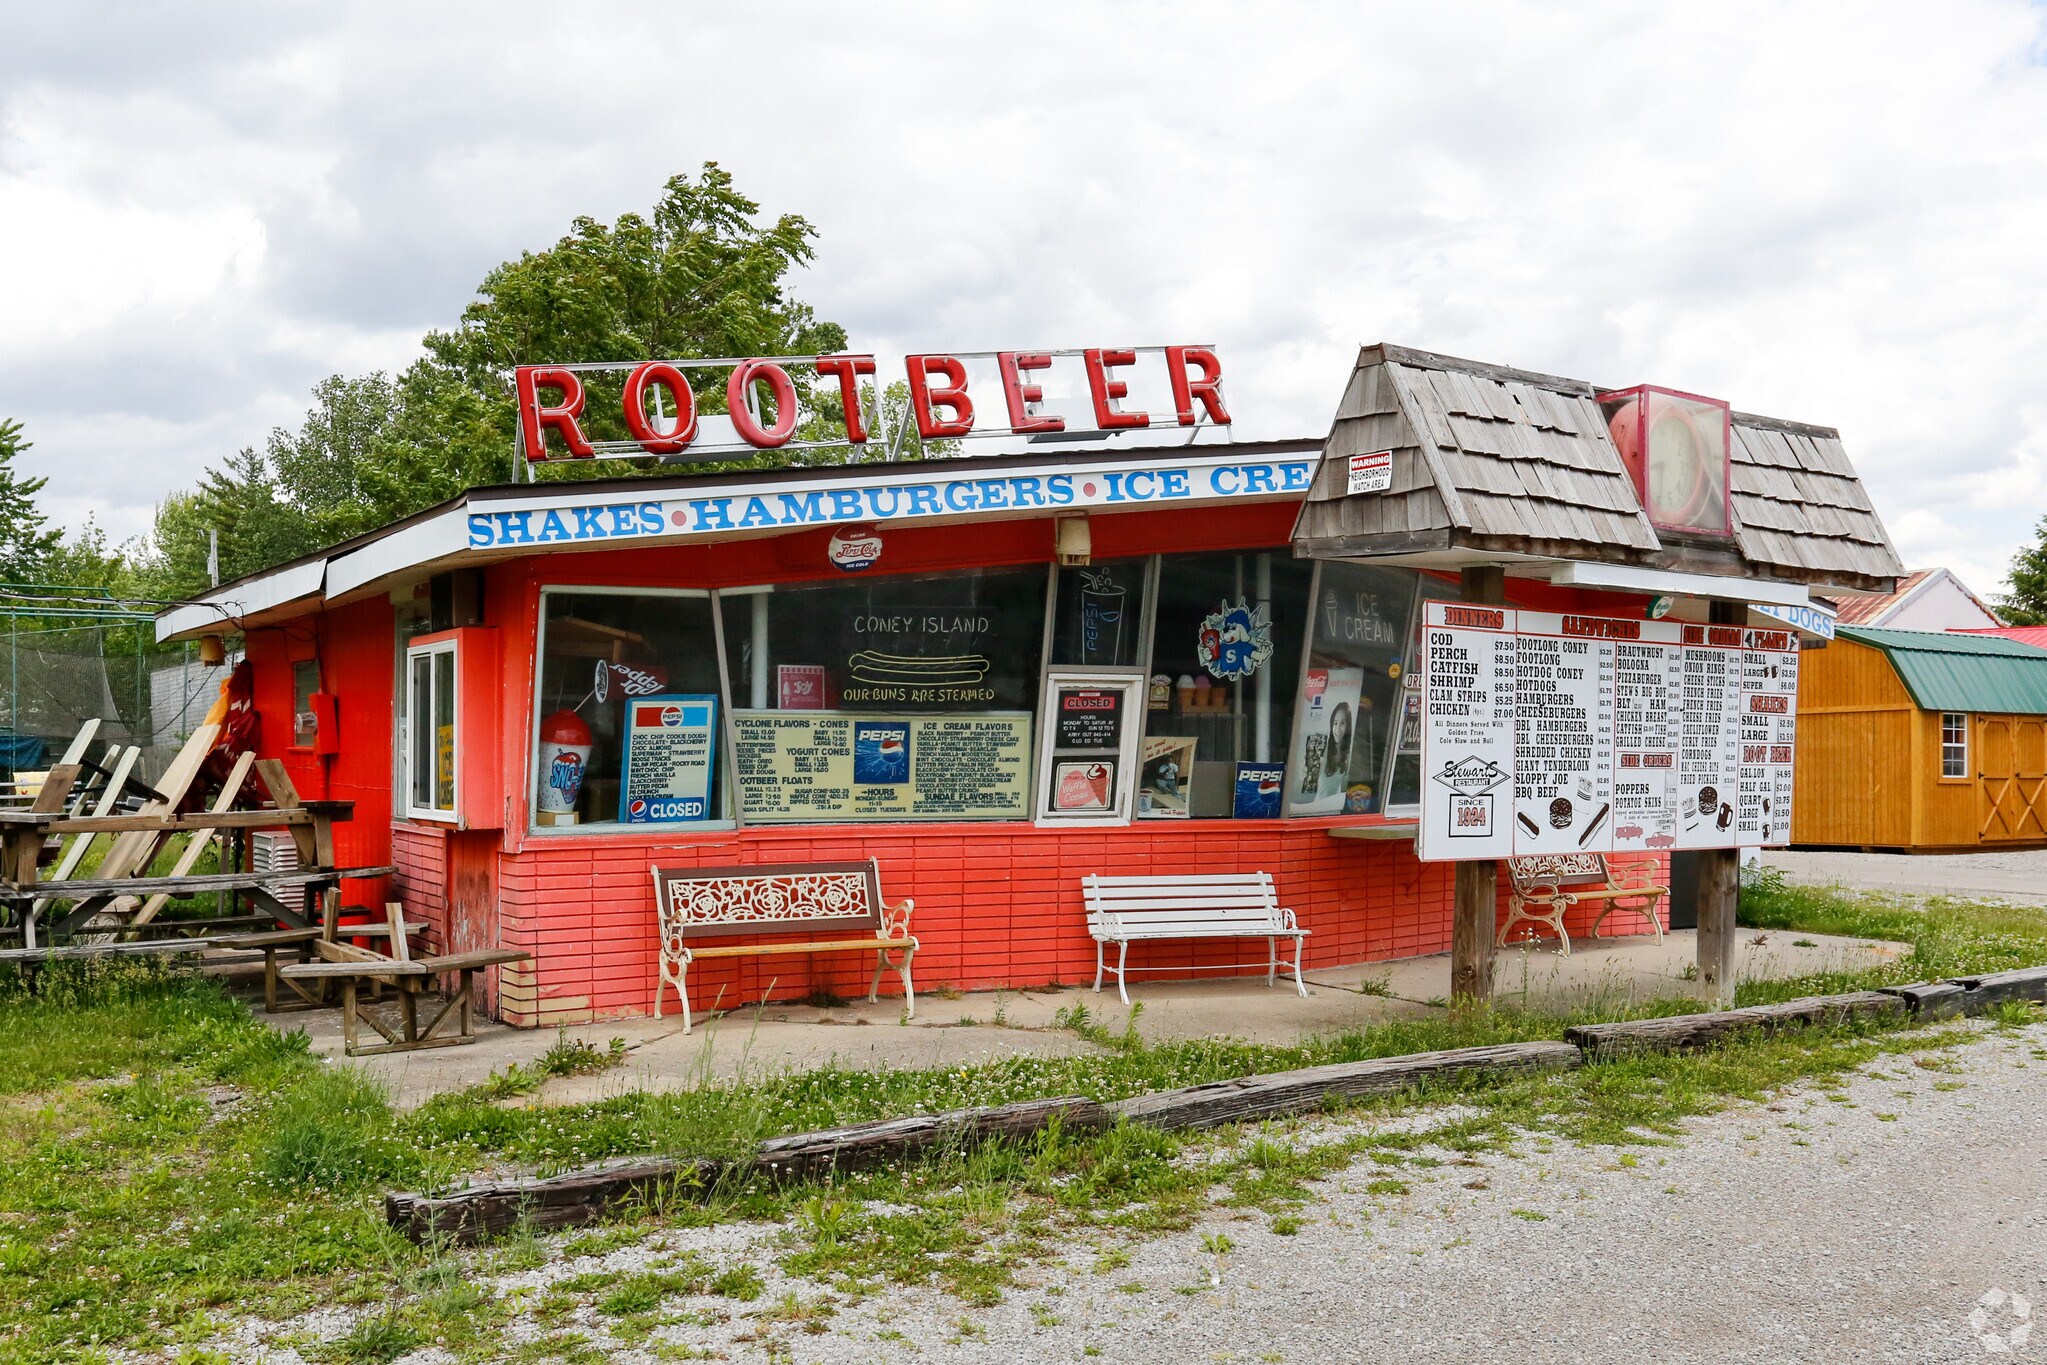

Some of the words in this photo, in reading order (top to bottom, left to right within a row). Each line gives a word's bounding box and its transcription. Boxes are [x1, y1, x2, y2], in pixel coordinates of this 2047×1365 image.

[1351, 455, 1389, 468] WARNING
[1371, 479, 1384, 489] AREA
[468, 501, 664, 547] SHAKES
[690, 475, 1074, 531] HAMBURGERS
[1103, 469, 1190, 501] ICE
[1356, 592, 1379, 616] ICE
[1444, 606, 1504, 629] DINNERS
[1788, 606, 1830, 636] DOGS
[854, 616, 912, 633] CONEY
[922, 616, 989, 633] ISLAND
[1086, 603, 1098, 651] PEPSI
[1345, 616, 1394, 643] CREAM
[1562, 615, 1640, 639] SANDWICHES
[1431, 632, 1453, 645] COD
[1494, 641, 1514, 651] $7.50
[1708, 627, 1742, 646] ORDERS
[1754, 631, 1788, 650] FLOATS
[1516, 638, 1559, 652] FOOTLONG
[1562, 641, 1589, 654] CONEY
[1617, 645, 1664, 658] BRAUTWRUST
[1225, 649, 1237, 663] S
[1431, 647, 1467, 660] PERCH
[1494, 654, 1514, 664] $8.50
[1516, 652, 1560, 665] FOOTLONG
[1685, 649, 1726, 662] MUSHROOMS
[1744, 653, 1766, 665] SMALL
[1782, 656, 1797, 666] $2.25
[1431, 660, 1478, 675] CATFISH
[1494, 668, 1514, 677] $8.50
[1617, 658, 1649, 670] BOLOGNA
[1684, 661, 1704, 673] ONION
[1706, 663, 1726, 674] RINGS
[1516, 666, 1552, 678] HOTDOG
[1556, 668, 1584, 680] CONEY
[1617, 672, 1662, 685] PIZZABURGER
[1743, 668, 1764, 678] LARGE
[1781, 669, 1796, 678] $3.50
[1430, 674, 1474, 688] SHRIMP
[1494, 683, 1514, 692] $6.50
[1516, 679, 1557, 692] HOTDOGS
[1684, 674, 1704, 686] CHEESE
[1743, 681, 1763, 690] SUPER
[1780, 681, 1795, 690] $6.00
[843, 688, 868, 701] OUR
[872, 688, 906, 701] BUNS
[911, 689, 934, 702] ARE
[937, 688, 995, 702] STEAMED
[1429, 688, 1453, 702] CLAM
[1457, 690, 1487, 703] STRIPS
[1495, 696, 1513, 705] $5.25
[1641, 686, 1652, 697] BIG
[1655, 686, 1667, 697] BOY
[1706, 687, 1723, 699] FRIES
[1067, 699, 1111, 707] CLOSED
[1516, 693, 1574, 705] HAMBURGERS
[1616, 698, 1631, 709] BLT
[1650, 699, 1666, 709] HAM
[1750, 695, 1788, 714] SHAKES
[1429, 703, 1470, 716] CHICKEN
[1493, 709, 1514, 718] $7.00
[1516, 706, 1586, 719] CHEESEBURGERS
[1616, 711, 1642, 722] CHICKEN
[1645, 711, 1667, 722] BREAST
[734, 719, 772, 728] CYCLONE
[774, 719, 810, 728] FLAVORS
[819, 720, 849, 728] CONES
[1705, 712, 1721, 723] FRIES
[1741, 715, 1769, 727] SMALL
[1779, 719, 1794, 728] $2.50
[923, 722, 937, 730] ICE
[975, 723, 1013, 731] FLAVORS
[1515, 720, 1530, 731] DBL
[1537, 721, 1588, 732] HAMBURGERS
[1616, 723, 1643, 734] CATFISH
[1682, 724, 1720, 735] CAULIFLOWER
[858, 730, 906, 741] PEPSI
[1515, 733, 1530, 744] DBL
[1536, 733, 1594, 745] CHEESEBURGERS
[1741, 729, 1768, 741] LARGE
[1779, 733, 1793, 741] $3.50
[1616, 736, 1642, 747] GRILLED
[1645, 736, 1666, 747] CHEESE
[1682, 736, 1699, 747] CURLY
[1701, 736, 1717, 747] FRIES
[786, 747, 819, 756] YOGURT
[821, 747, 850, 756] CONES
[1515, 747, 1556, 758] SHREDDED
[1560, 747, 1592, 758] CHICKEN
[1681, 749, 1712, 760] CORNDOGS
[1743, 745, 1767, 763] ROOT
[1770, 746, 1792, 763] BEER
[1515, 760, 1540, 771] GIANT
[1544, 760, 1590, 771] TENDERLOIN
[1621, 753, 1640, 767] SIDE
[1643, 754, 1673, 767] ORDERS
[1238, 770, 1283, 781] PEPSI
[1515, 773, 1548, 784] SLOPPY
[1552, 773, 1569, 784] JOE
[1739, 767, 1765, 779] GALLON
[1777, 770, 1791, 778] $4.95
[782, 777, 813, 785] FLOATS
[1062, 780, 1087, 794] Waffle
[1739, 782, 1756, 792] HALF
[867, 788, 895, 796] HOURS
[1515, 786, 1532, 800] BBQ
[1537, 786, 1559, 798] BEEF
[1615, 783, 1650, 795] POPPERS
[1064, 791, 1089, 803] Cones
[1615, 797, 1642, 808] POTATOE
[1644, 797, 1662, 808] SKINS
[1739, 795, 1762, 807] QUART
[650, 801, 703, 818] CLOSED
[1739, 808, 1758, 818] LARGE
[1457, 807, 1486, 826] 1924
[1738, 821, 1758, 831] SMALL
